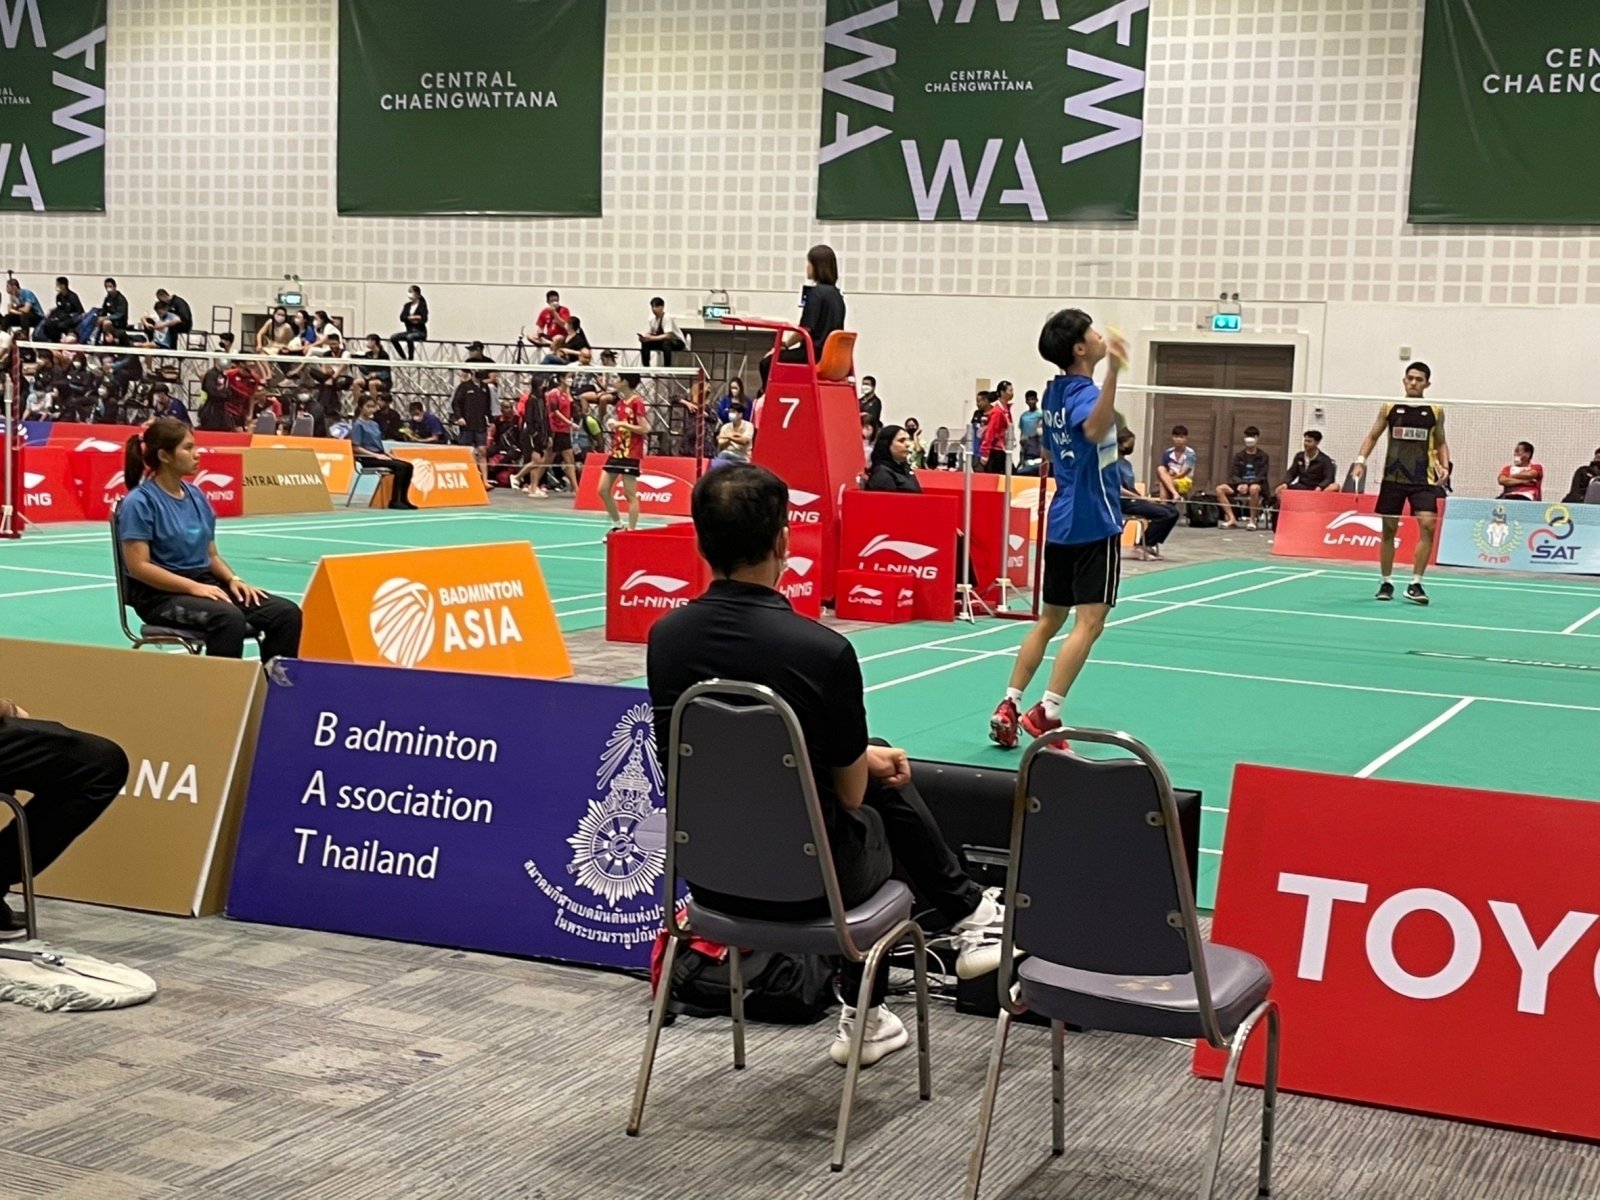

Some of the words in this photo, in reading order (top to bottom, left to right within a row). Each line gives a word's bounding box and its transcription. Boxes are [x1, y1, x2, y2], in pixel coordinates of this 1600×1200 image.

[420, 71, 517, 89] CENTRAL
[950, 69, 1008, 80] CENTRAL
[924, 81, 1034, 92] CHAENGWATTANA
[380, 91, 558, 110] CHAENGWATTANA
[901, 138, 1049, 220] WA
[779, 398, 800, 429] 7
[437, 471, 470, 489] ASIA
[1531, 545, 1582, 559] SAT
[438, 580, 524, 606] BADMINTON
[444, 605, 523, 653] ASIA
[1277, 872, 1600, 1016] TOY
